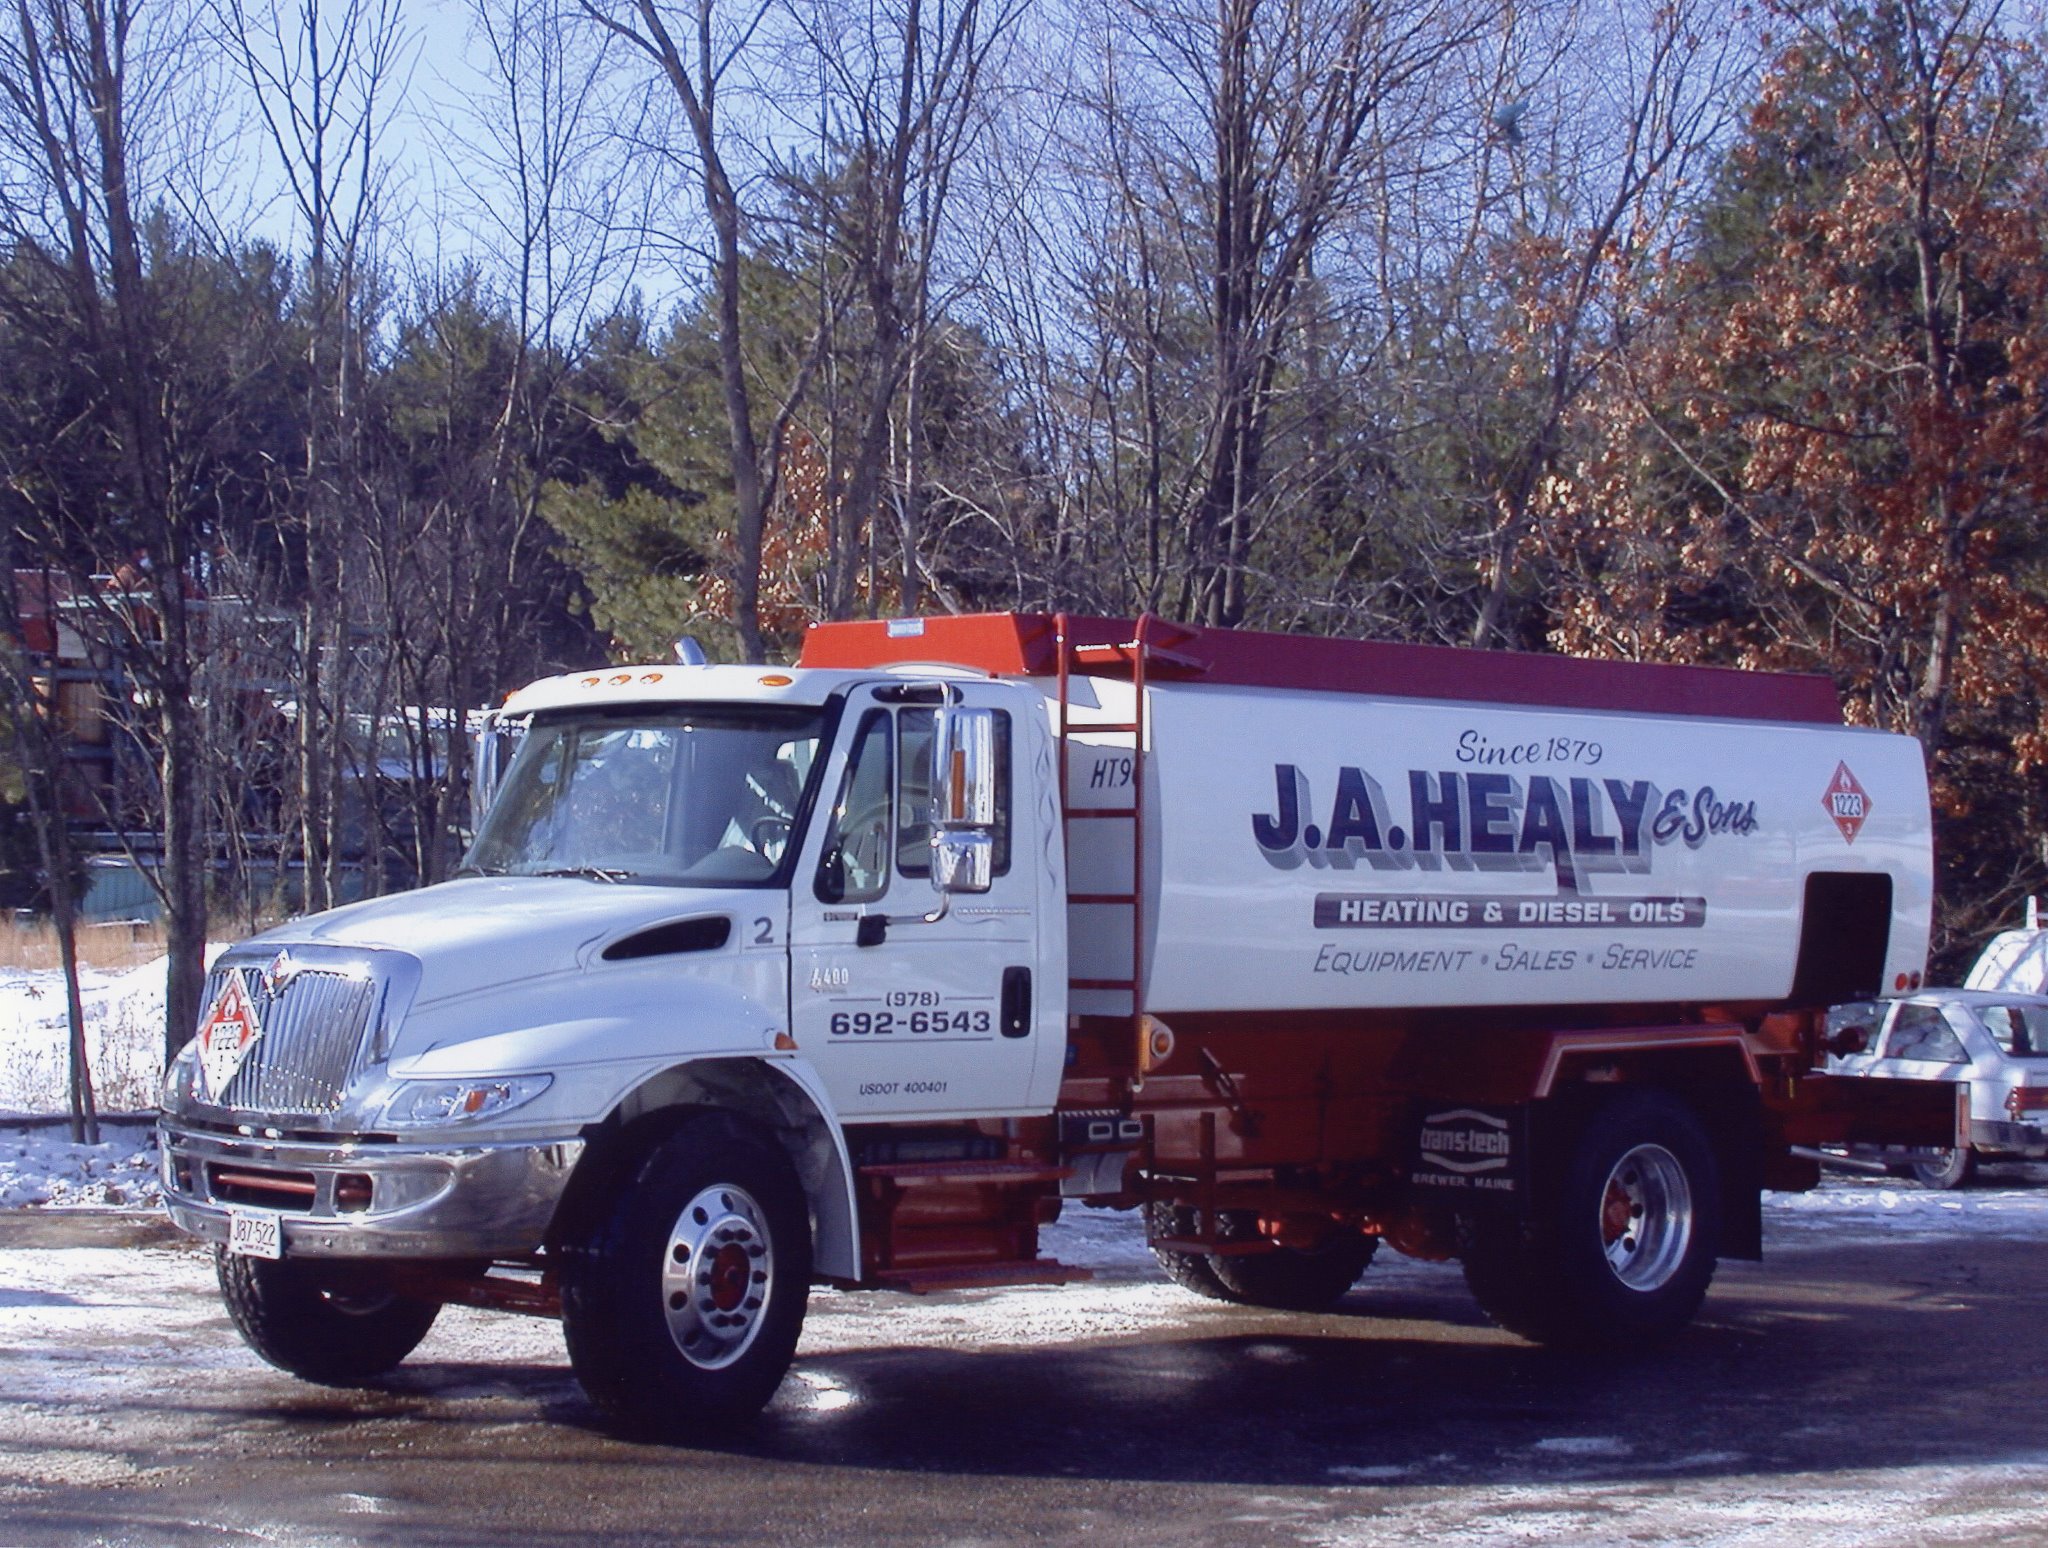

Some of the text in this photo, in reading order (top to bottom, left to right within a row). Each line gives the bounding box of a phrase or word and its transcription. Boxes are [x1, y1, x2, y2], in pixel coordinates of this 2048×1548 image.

[1456, 730, 1603, 765] Since 1879
[1834, 794, 1861, 816] 1223
[1339, 900, 1686, 923] HEATING & DIESEL OILS
[753, 916, 774, 945] 2
[886, 991, 940, 1007] (978)
[830, 1010, 991, 1035] 692-6543
[859, 1081, 948, 1096] USDOT 400401
[1474, 1177, 1514, 1191] MAINE
